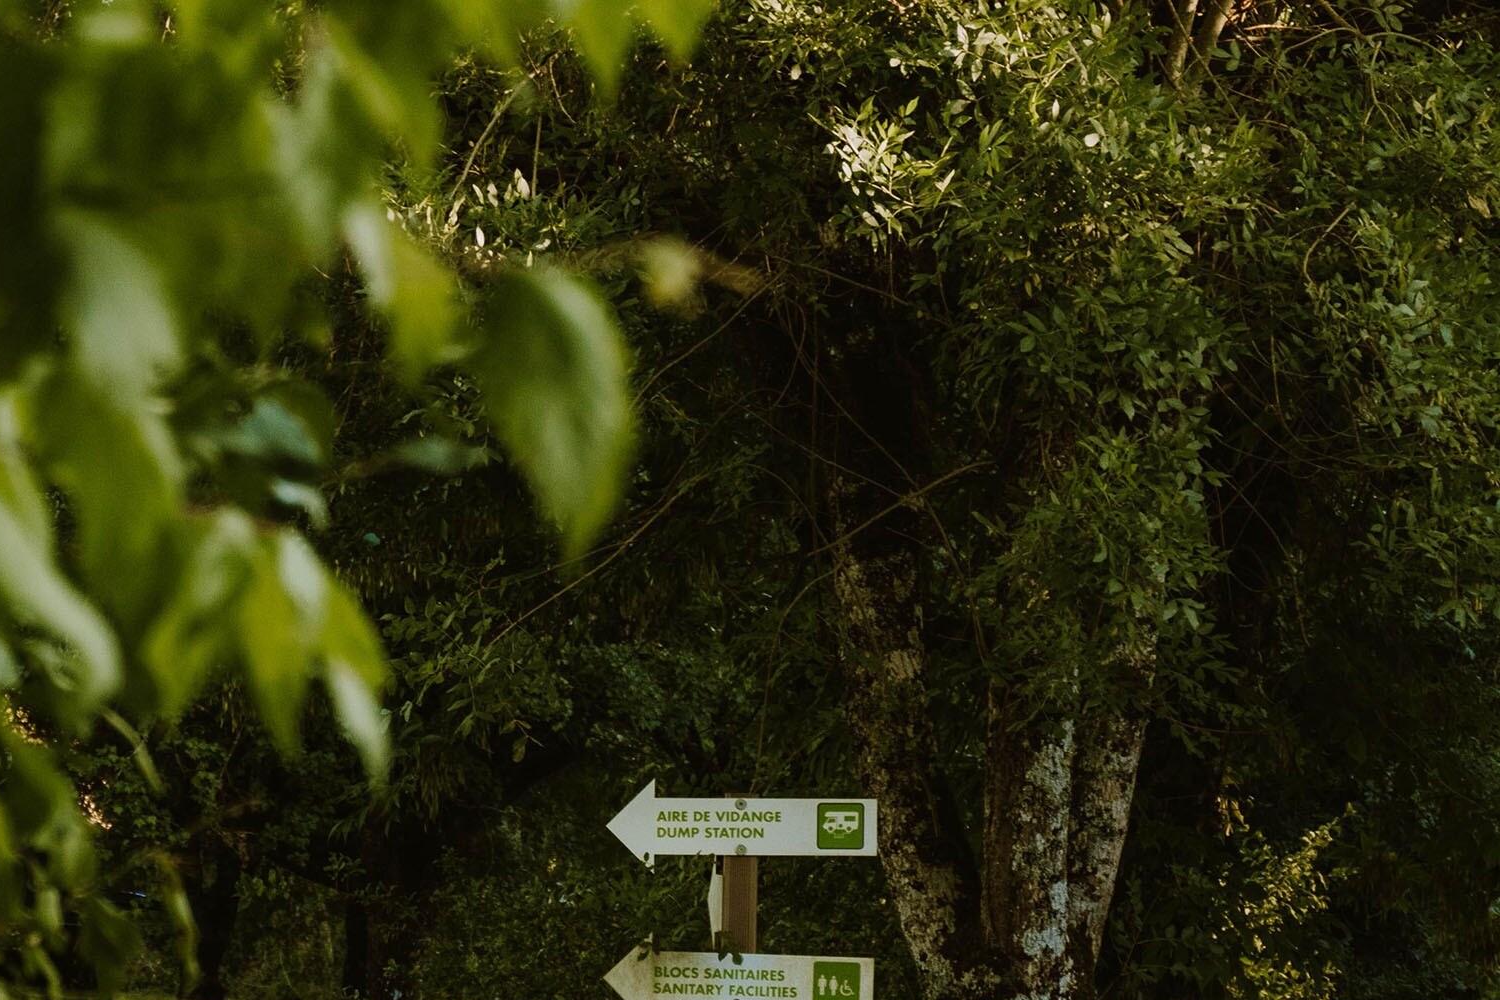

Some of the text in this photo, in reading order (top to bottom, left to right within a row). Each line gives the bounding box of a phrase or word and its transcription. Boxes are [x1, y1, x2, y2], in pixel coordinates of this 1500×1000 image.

[657, 811, 782, 822] AIRE DE VIDANGE
[656, 827, 764, 838] DUMP STATION
[653, 966, 785, 981] BLOCS SANITAIRES
[653, 983, 797, 998] SANITARY FACILITIES
